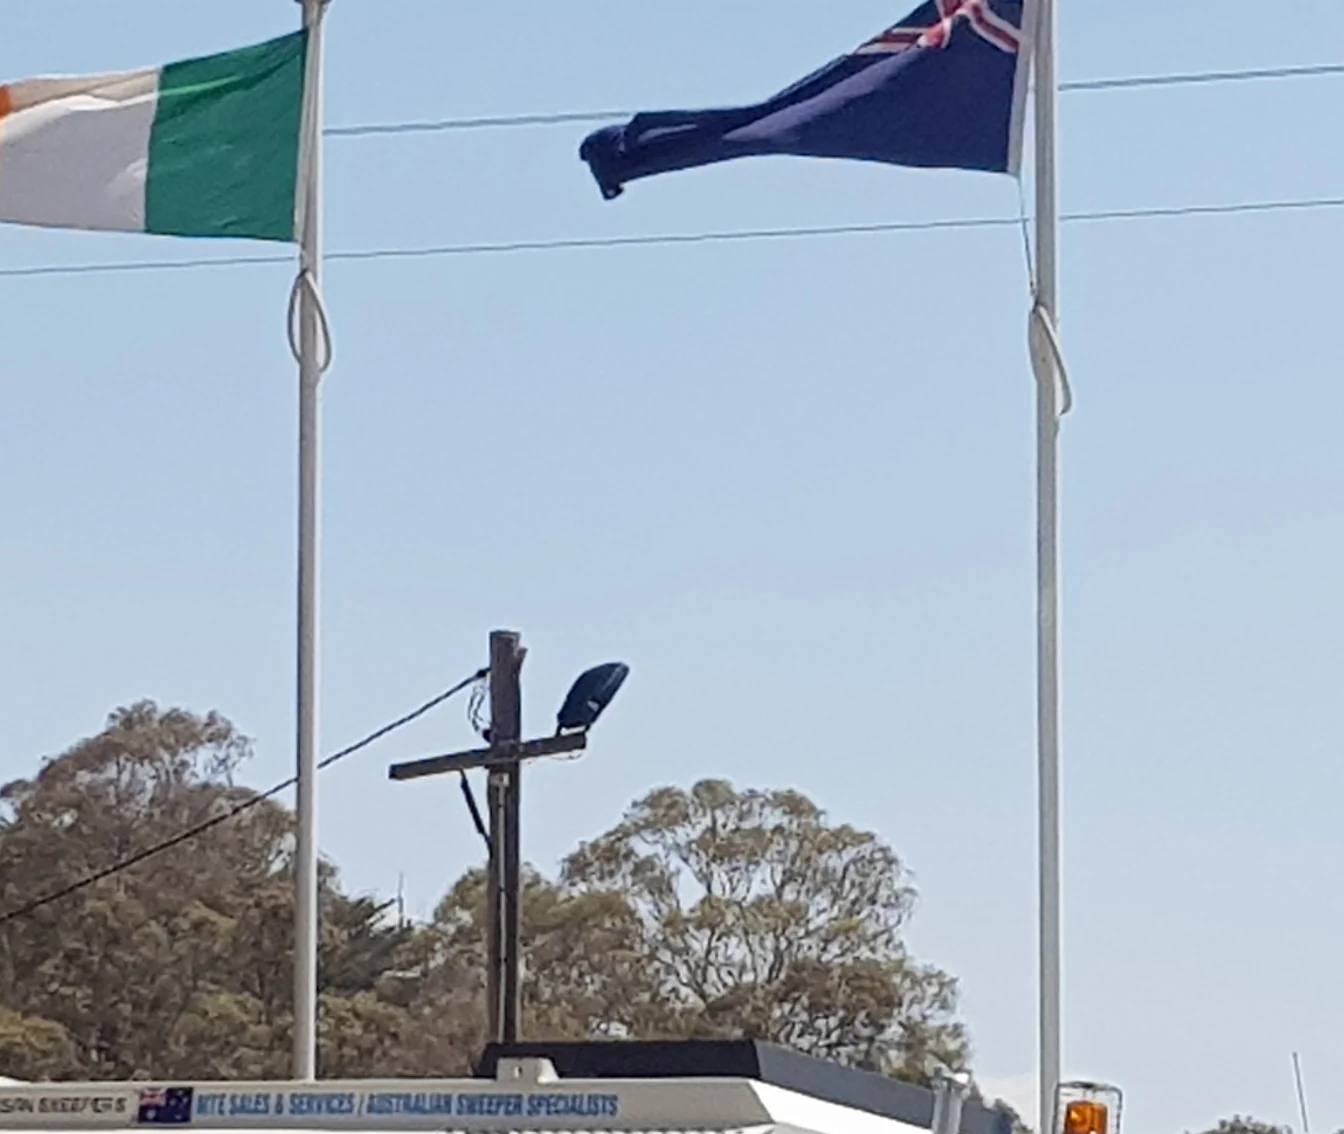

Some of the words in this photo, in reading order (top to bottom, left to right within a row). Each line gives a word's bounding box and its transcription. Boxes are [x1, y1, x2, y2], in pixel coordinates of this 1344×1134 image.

[229, 1093, 270, 1114] SALES
[289, 1092, 354, 1114] SERVICES
[367, 1094, 452, 1114] AUSTRALIAN
[457, 1094, 523, 1115] SWEEPER
[527, 1094, 618, 1116] SPECIALISTS
